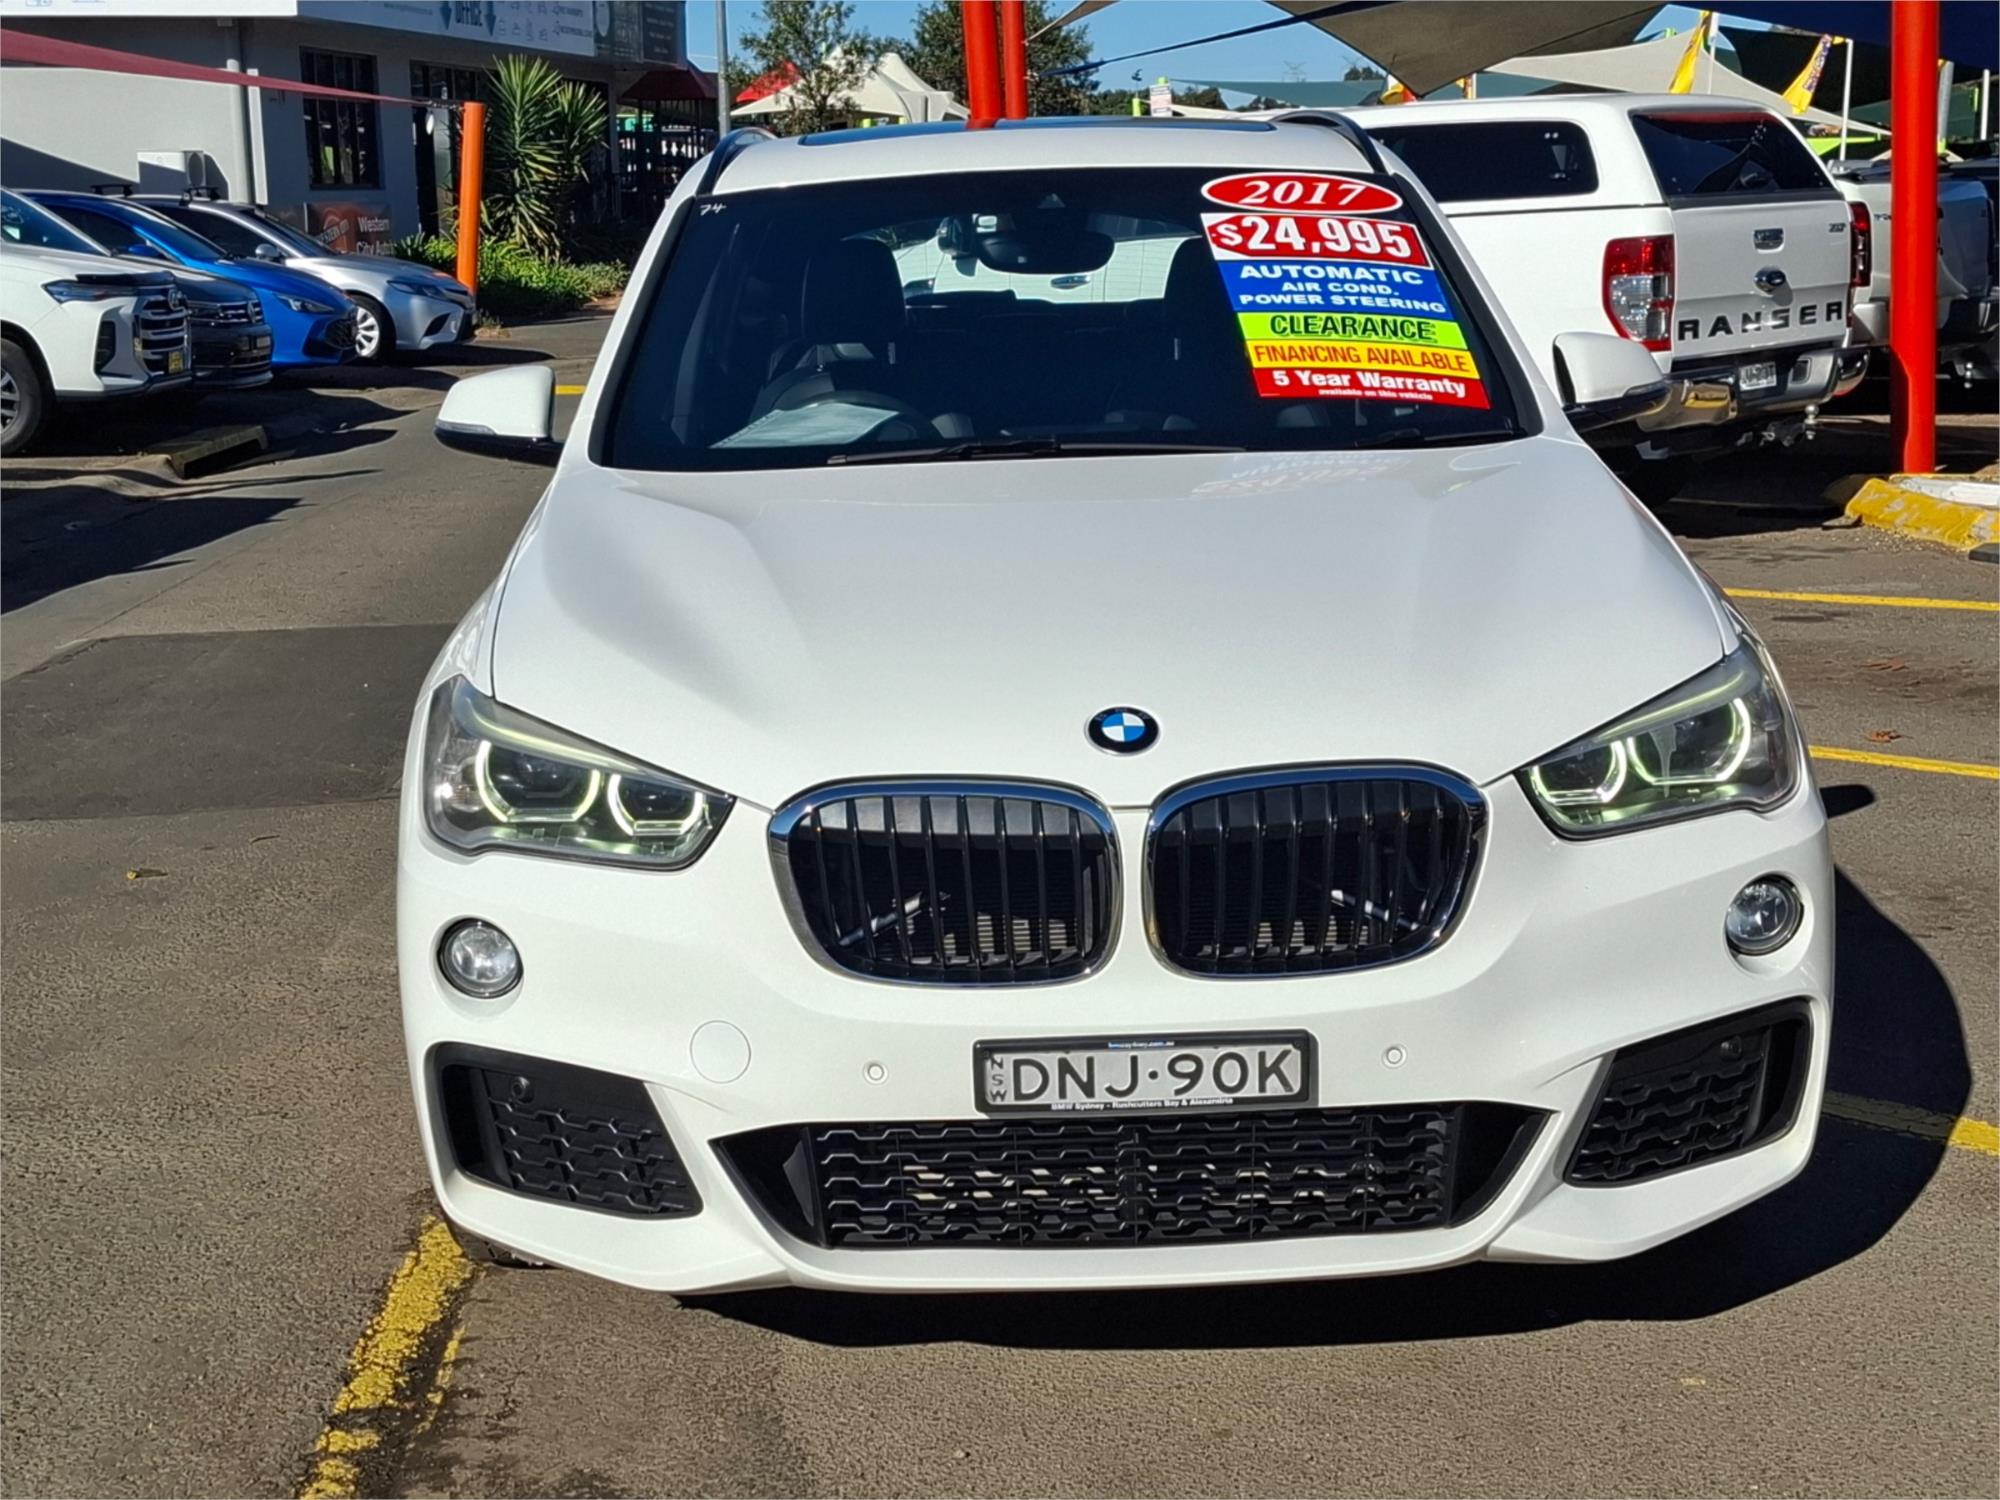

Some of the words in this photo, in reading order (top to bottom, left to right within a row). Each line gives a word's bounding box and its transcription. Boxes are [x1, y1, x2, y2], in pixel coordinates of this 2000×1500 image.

[1239, 180, 1368, 206] 2017
[358, 217, 390, 232] Western
[1212, 216, 1411, 258] $24,995
[1240, 265, 1424, 285] AUTOMATIC
[1282, 281, 1322, 292] AIR
[1328, 282, 1400, 296] COND.
[1239, 294, 1325, 305] POWER
[1330, 295, 1447, 313] STEERING
[1270, 314, 1435, 341] CLEARANCE
[1678, 301, 1842, 341] RANGER
[1254, 344, 1361, 363] FINANCING
[1367, 346, 1471, 372] AVAILABLE
[1272, 370, 1290, 386] 5
[1294, 370, 1351, 388] Year
[1356, 371, 1466, 398] Warranty
[1378, 390, 1397, 398] this
[1398, 392, 1433, 400] vehicle
[990, 1055, 1007, 1102] NSW
[1075, 1102, 1104, 1111] Sydney
